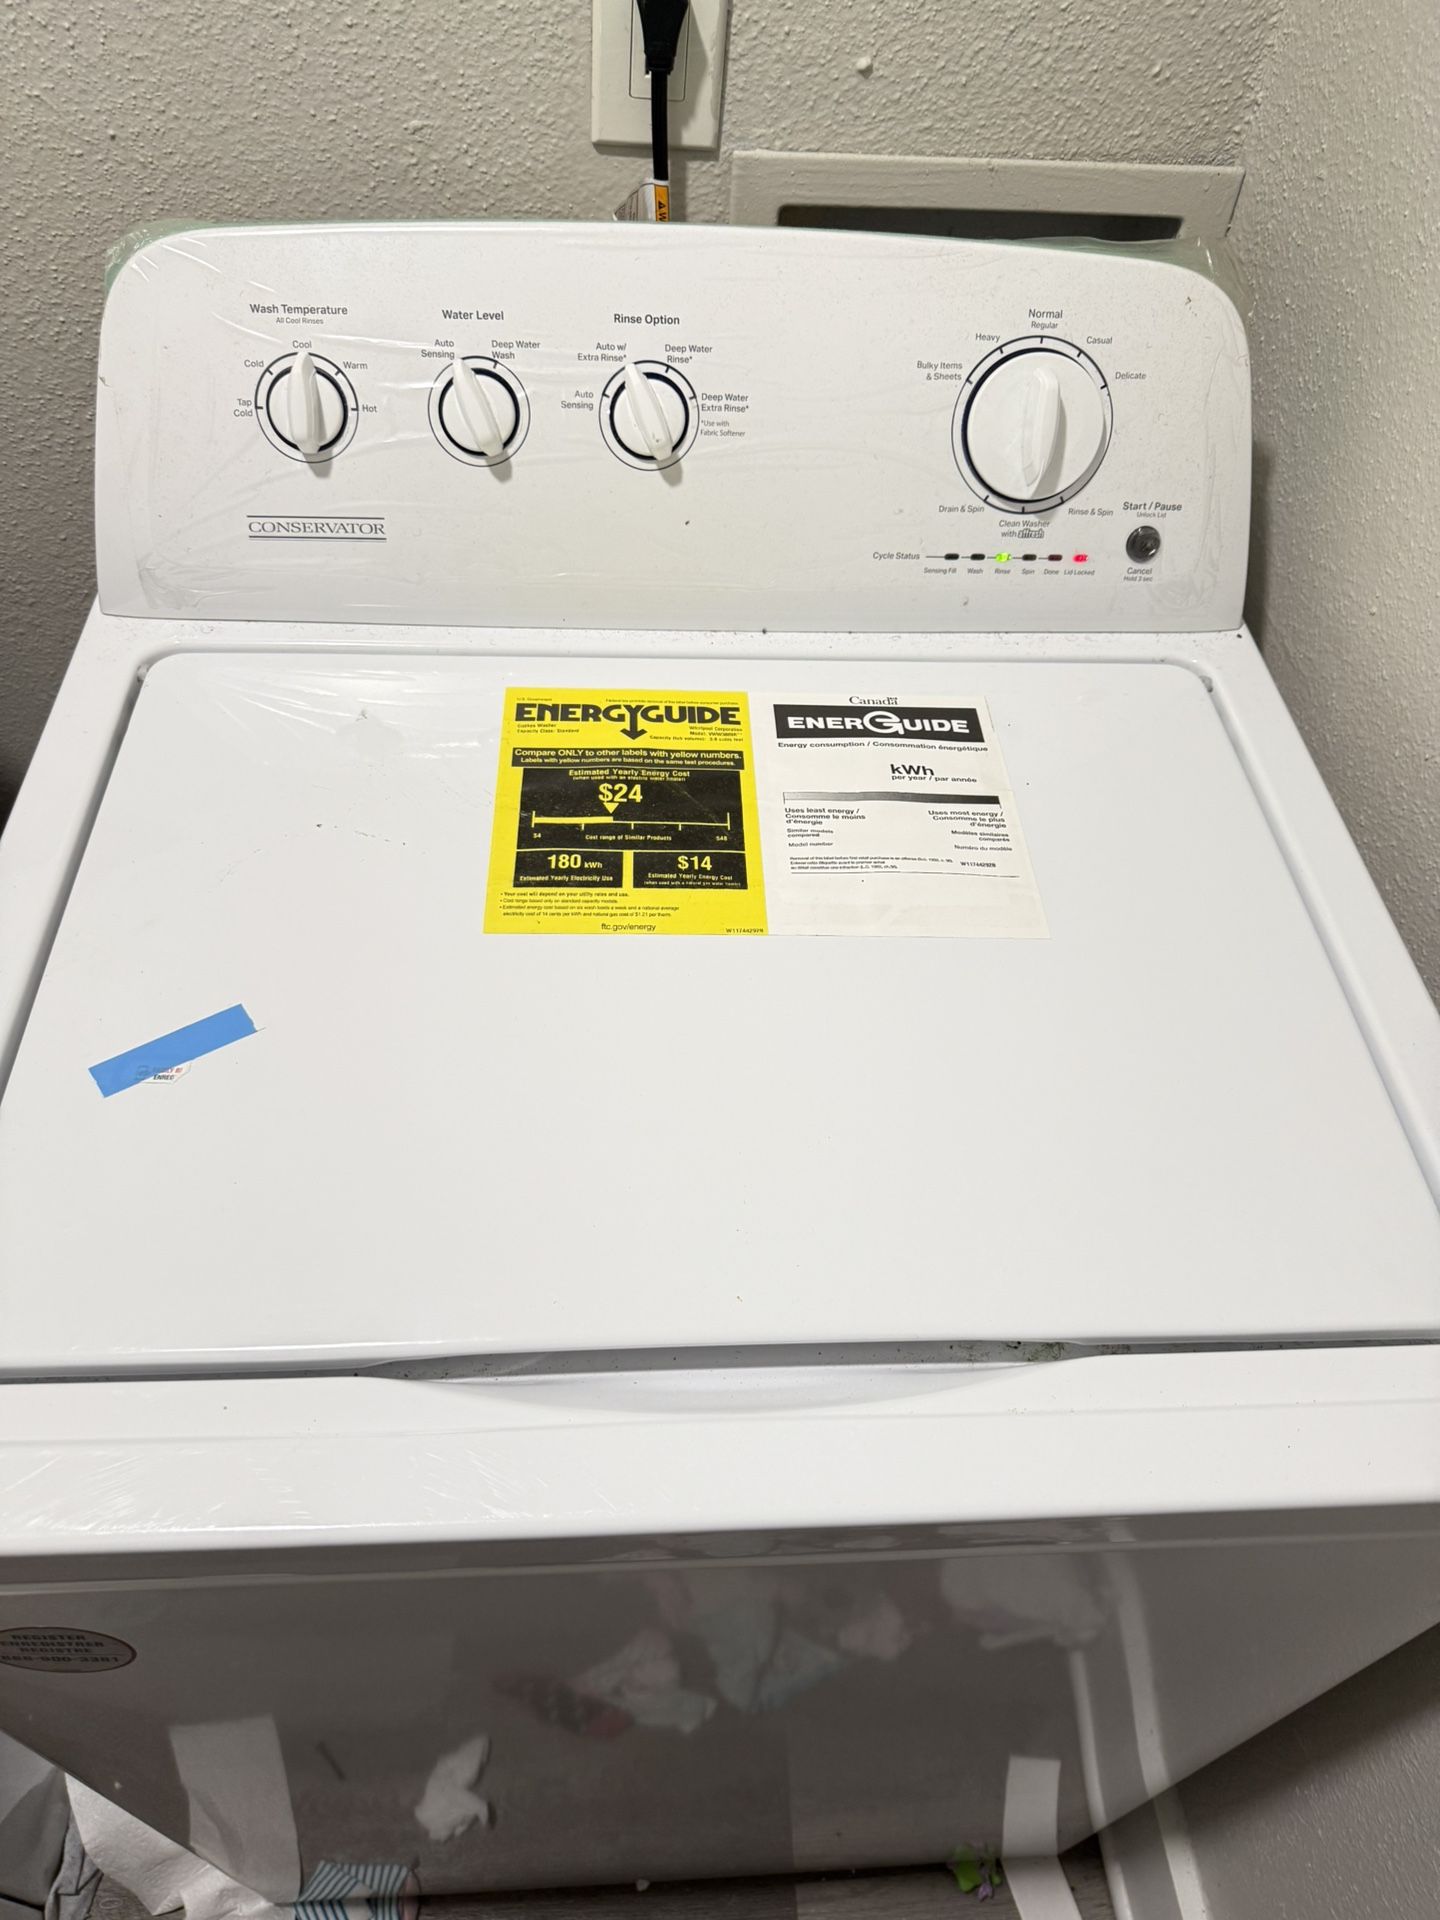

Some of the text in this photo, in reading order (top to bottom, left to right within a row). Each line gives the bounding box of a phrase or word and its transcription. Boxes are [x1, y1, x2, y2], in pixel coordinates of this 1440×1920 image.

[249, 304, 348, 316] Wash Temperature
[442, 310, 504, 320] Water Level
[1028, 309, 1063, 319] Normal
[614, 314, 680, 326] Rinse Option
[1031, 321, 1058, 330] Regular
[976, 333, 1001, 343] Heavy
[1086, 336, 1113, 344] Casual
[292, 340, 312, 349] Cool
[434, 339, 455, 348] Auto
[491, 340, 541, 350] Deep Water
[596, 342, 616, 351] Auto
[665, 344, 712, 354] Deep Water
[421, 349, 455, 361] Sensing
[491, 351, 515, 361] Wash
[578, 353, 599, 361] Extra
[244, 359, 264, 368] Cold
[343, 361, 368, 369] Warm
[917, 360, 963, 371] Bulky Items
[934, 372, 962, 381] Sheets
[1115, 372, 1147, 380] Delicate
[574, 390, 594, 399] Auto
[702, 393, 748, 402] Deep Water
[237, 398, 253, 408] Tap
[561, 401, 594, 411] Sensing
[701, 403, 722, 412] Extra
[233, 409, 253, 417] Cold
[362, 404, 377, 413] Hot
[720, 429, 746, 437] Softener
[939, 505, 959, 513] Drain
[967, 505, 985, 514] Spin
[1123, 501, 1147, 511] Start
[1154, 502, 1182, 511] Pause
[1097, 508, 1114, 518] Spin
[249, 522, 385, 535] CONSERVATOR
[1022, 519, 1051, 529] Washer
[873, 552, 920, 561] Cycle Status
[1127, 567, 1153, 575] Cancel
[849, 696, 898, 705] Canada
[515, 703, 741, 725] ENERGYGUIDE
[788, 711, 969, 735] ENERGUIDE
[515, 749, 556, 757] Compare
[558, 749, 584, 757] ONLY
[622, 750, 648, 759] labels
[670, 751, 699, 759] yellow
[610, 769, 640, 777] Yearly
[639, 770, 670, 778] Energy
[890, 764, 934, 776] kWh
[598, 783, 643, 803] $24
[548, 854, 581, 869] 180
[678, 856, 712, 871] $14
[601, 923, 656, 932] ftc.gov/energy
